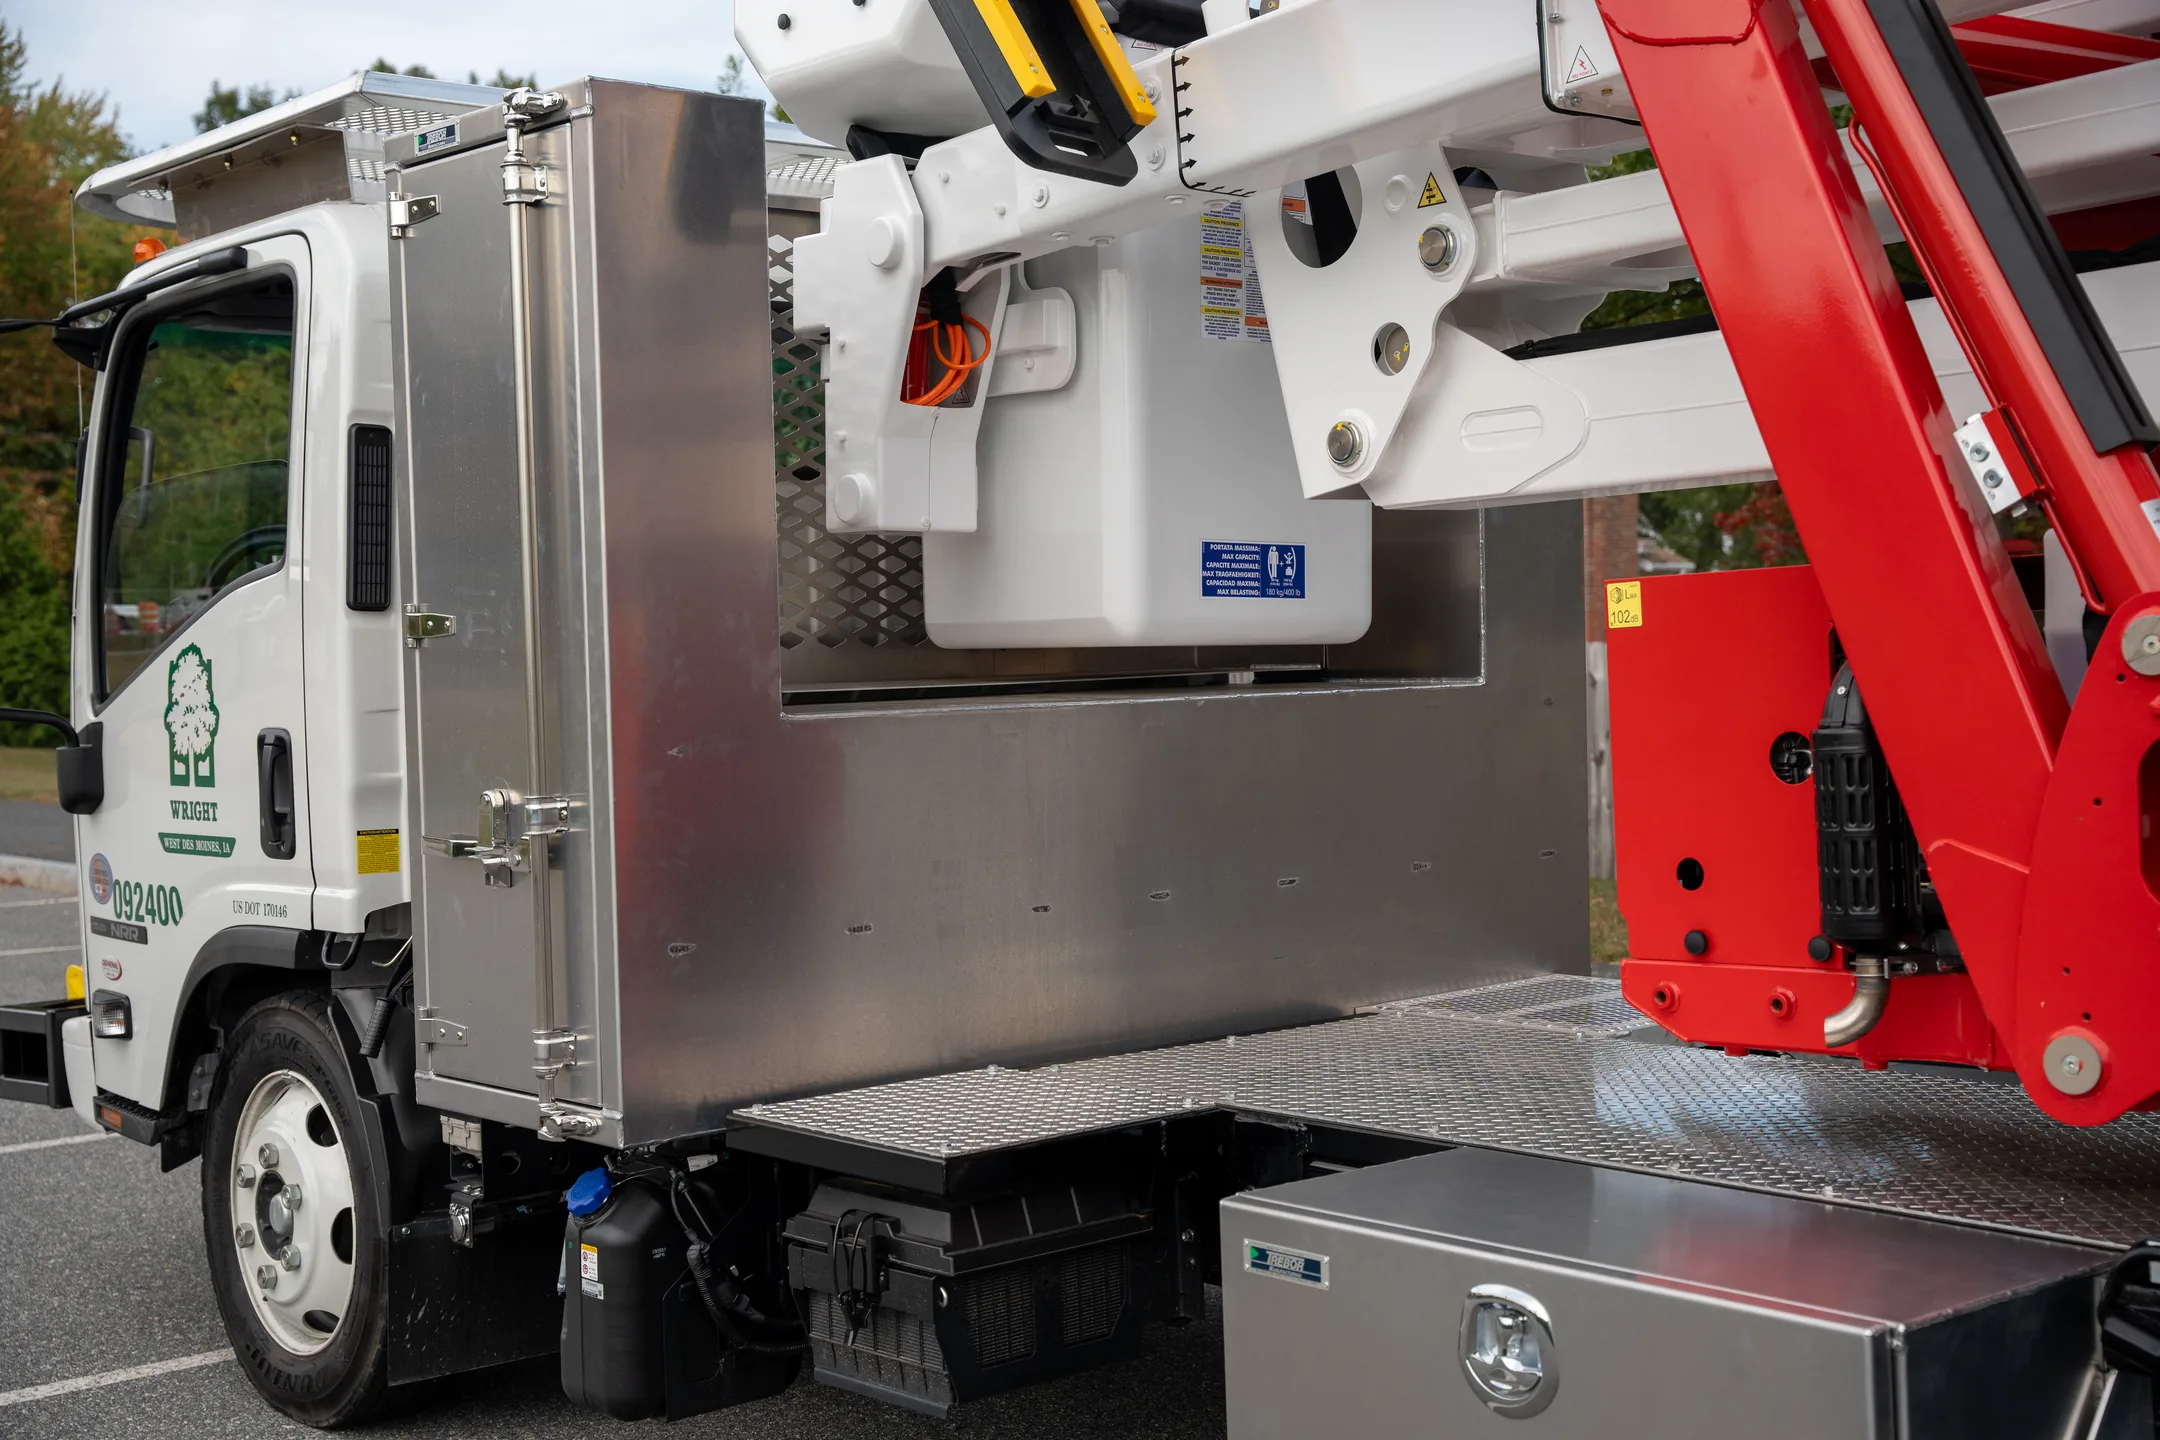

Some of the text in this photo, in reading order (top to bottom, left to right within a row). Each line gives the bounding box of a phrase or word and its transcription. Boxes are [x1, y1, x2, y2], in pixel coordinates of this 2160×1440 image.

[1210, 543, 1234, 551] PORTATA
[1234, 544, 1260, 552] MASSIMA:
[1231, 562, 1260, 570] MAXIMALE:
[1206, 579, 1260, 588] CAPACIDAD MAXIMA:
[1265, 588, 1276, 596] 180
[170, 799, 218, 822] WRIGHT
[163, 837, 231, 855] WEST DES MOINES, IA
[113, 878, 184, 927] 092400
[232, 900, 288, 919] US DOT 170146
[110, 922, 140, 941] NRR
[1266, 1250, 1306, 1273] TREBOR
